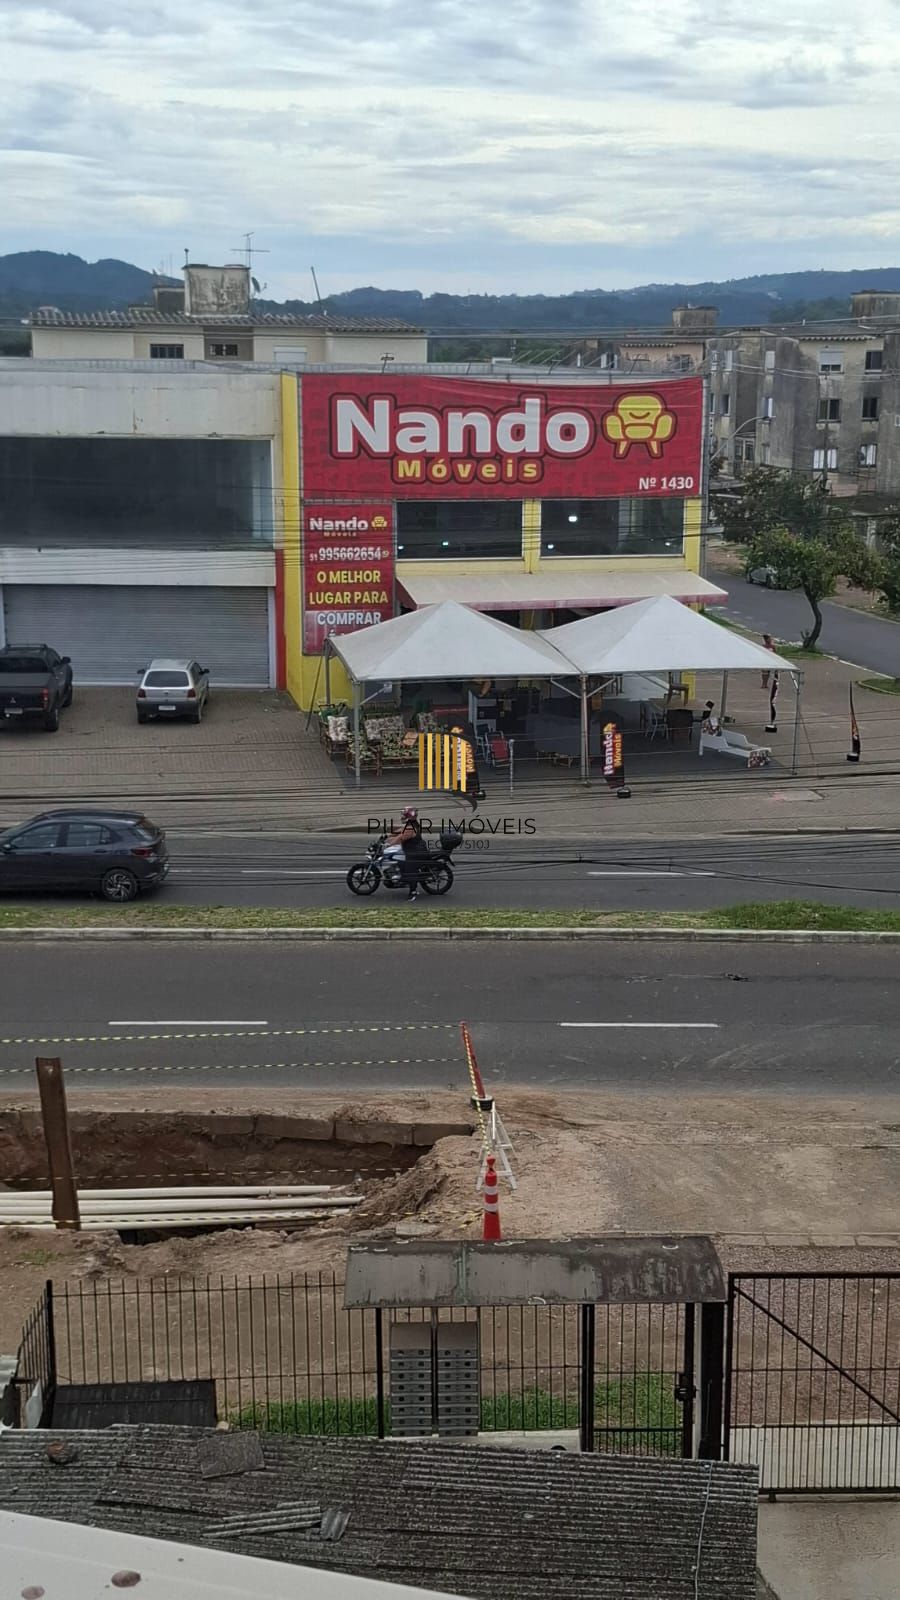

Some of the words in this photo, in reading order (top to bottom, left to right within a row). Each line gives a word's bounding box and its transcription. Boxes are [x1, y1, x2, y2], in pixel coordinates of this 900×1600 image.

[335, 398, 591, 454] Nando
[397, 459, 538, 479] Móveis
[638, 477, 657, 490] Nº
[660, 476, 693, 490] 1430
[309, 517, 368, 530] Nando
[319, 547, 381, 560] 995662654
[317, 572, 326, 583] O
[329, 571, 380, 583] MELHOR
[309, 593, 351, 604] LUGAR
[354, 592, 388, 603] PARA
[317, 612, 381, 625] COMPRAR
